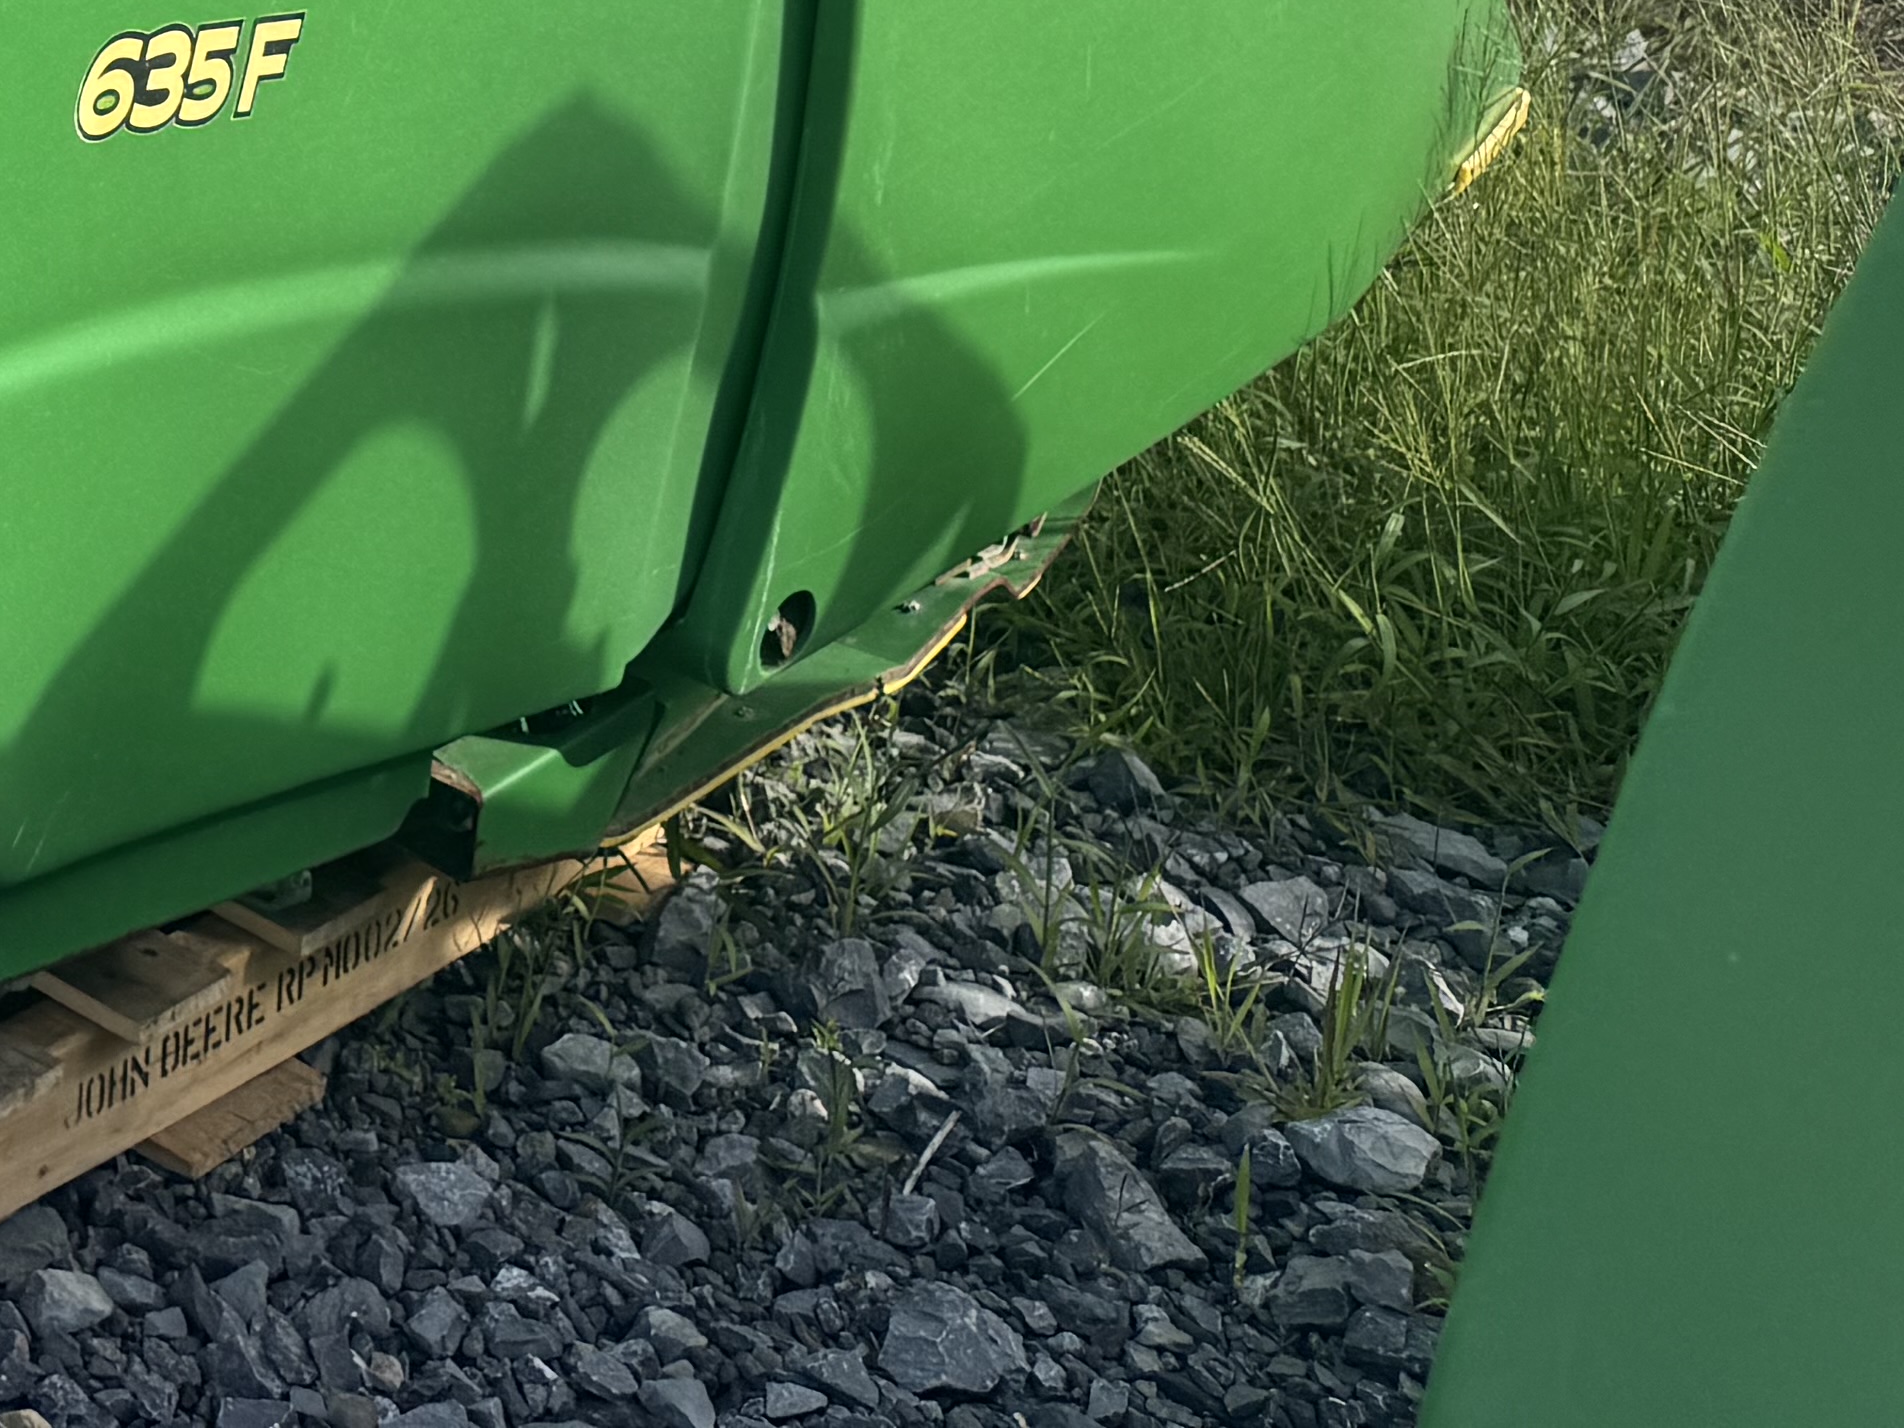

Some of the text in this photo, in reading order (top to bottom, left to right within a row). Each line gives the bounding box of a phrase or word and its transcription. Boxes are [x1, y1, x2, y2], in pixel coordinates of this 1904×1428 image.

[76, 12, 305, 140] 635F
[64, 1046, 151, 1129] JOHN
[159, 982, 267, 1078] DEERE
